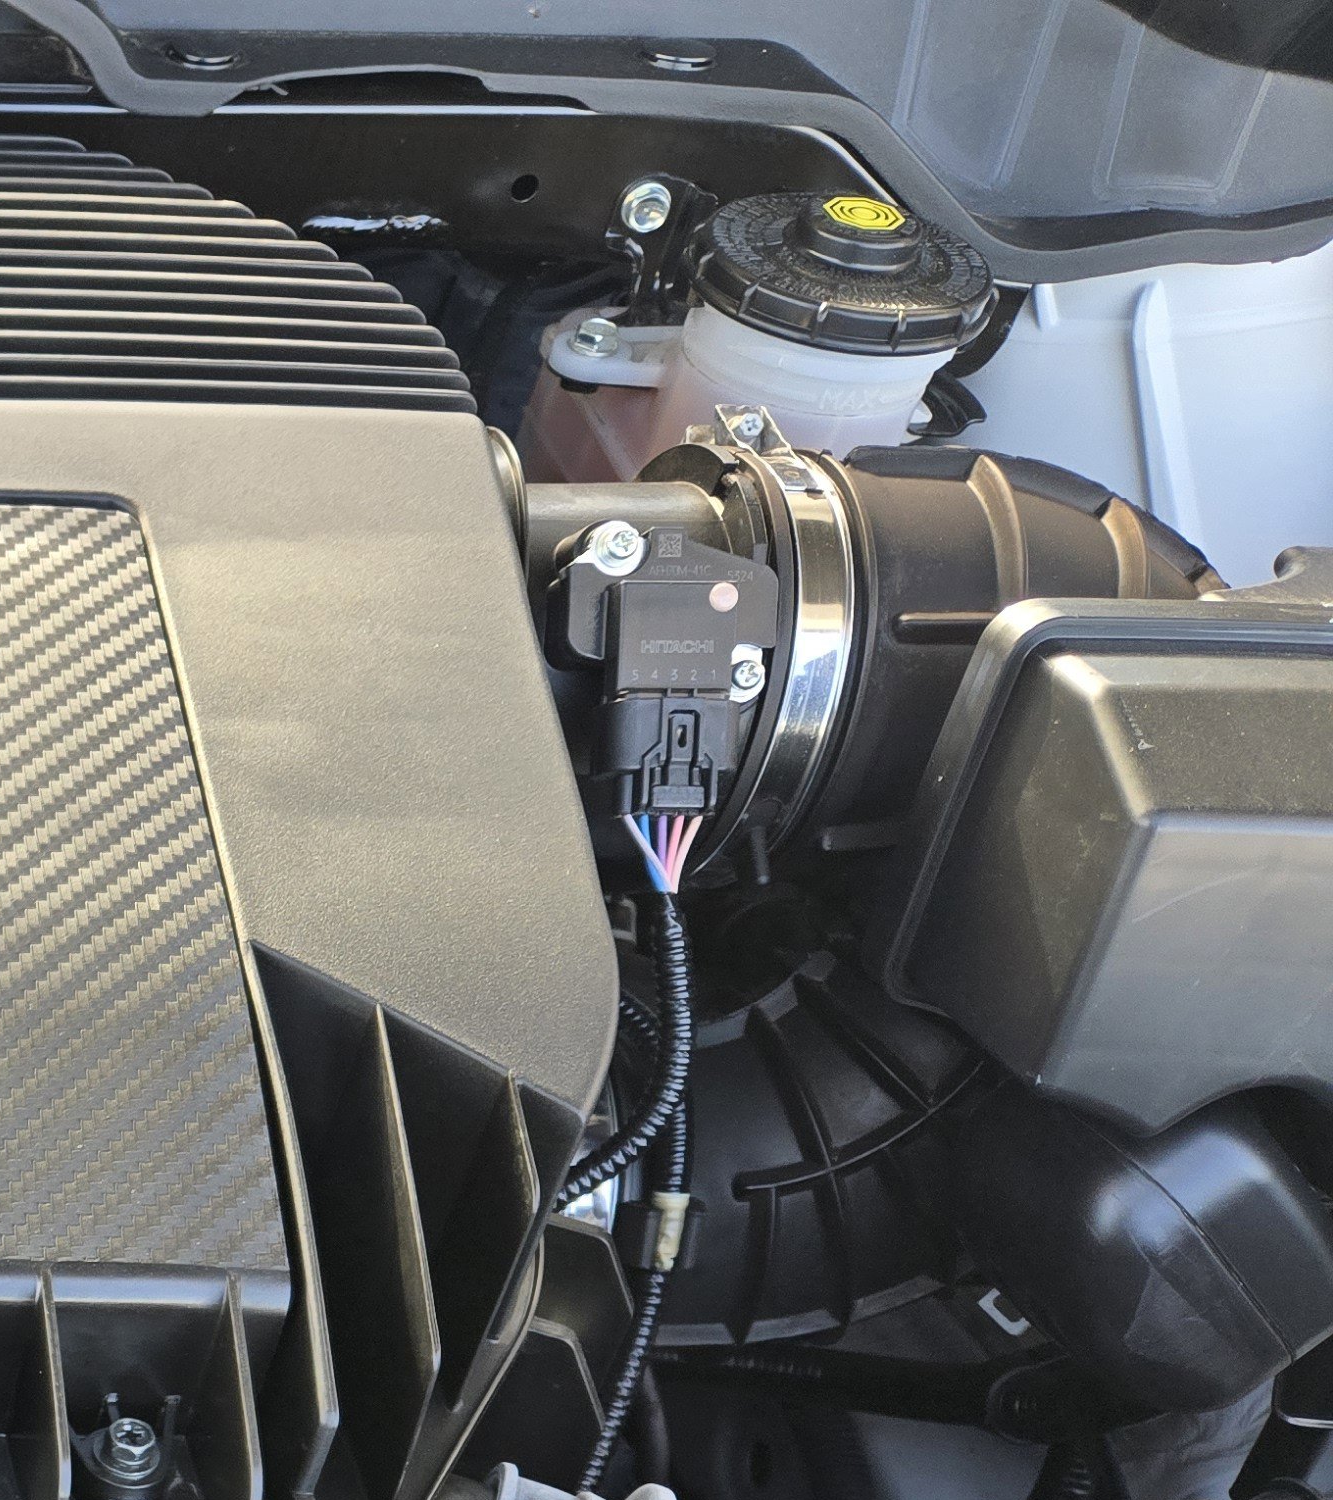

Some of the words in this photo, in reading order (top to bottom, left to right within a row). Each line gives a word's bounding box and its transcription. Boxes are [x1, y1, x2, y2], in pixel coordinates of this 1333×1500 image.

[640, 640, 715, 654] HITACHI
[632, 668, 639, 682] 5
[651, 668, 659, 682] 4
[670, 668, 679, 682] 3
[690, 668, 698, 682] 2
